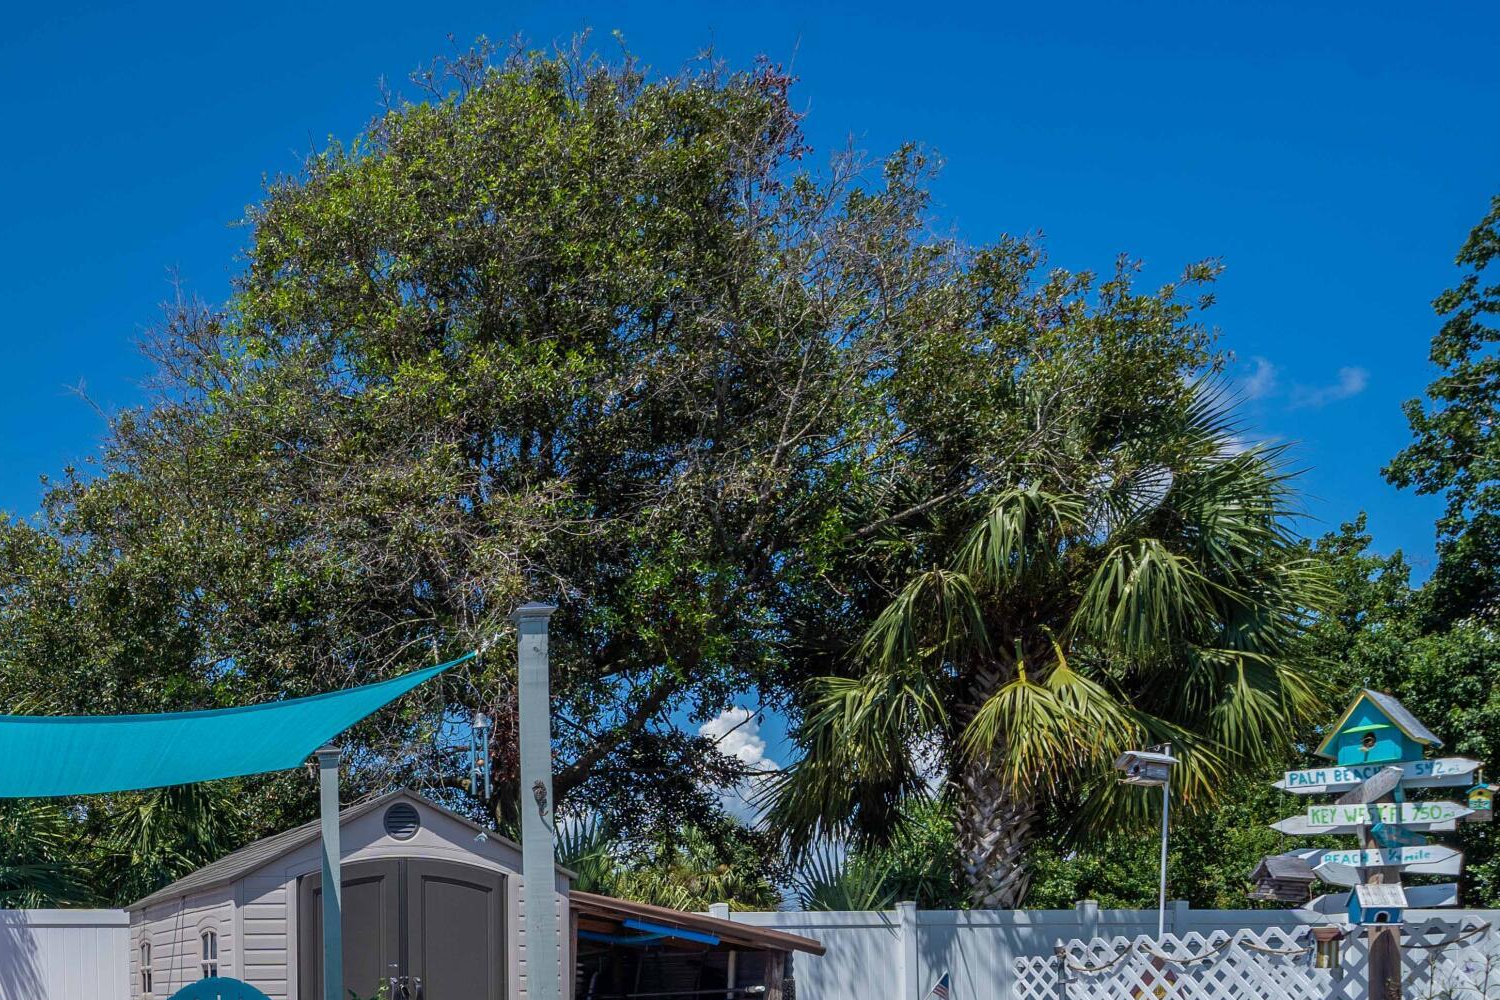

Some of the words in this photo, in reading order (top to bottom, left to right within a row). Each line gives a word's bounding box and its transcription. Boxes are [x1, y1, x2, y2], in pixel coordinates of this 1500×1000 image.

[1288, 771, 1326, 786] PALM
[1415, 762, 1444, 775] 542
[1311, 808, 1337, 824] KEY
[1344, 807, 1384, 823] WEST
[1390, 807, 1407, 822] FL
[1412, 805, 1442, 821] 750
[1324, 852, 1369, 864] BEACH
[1404, 850, 1431, 861] mile
